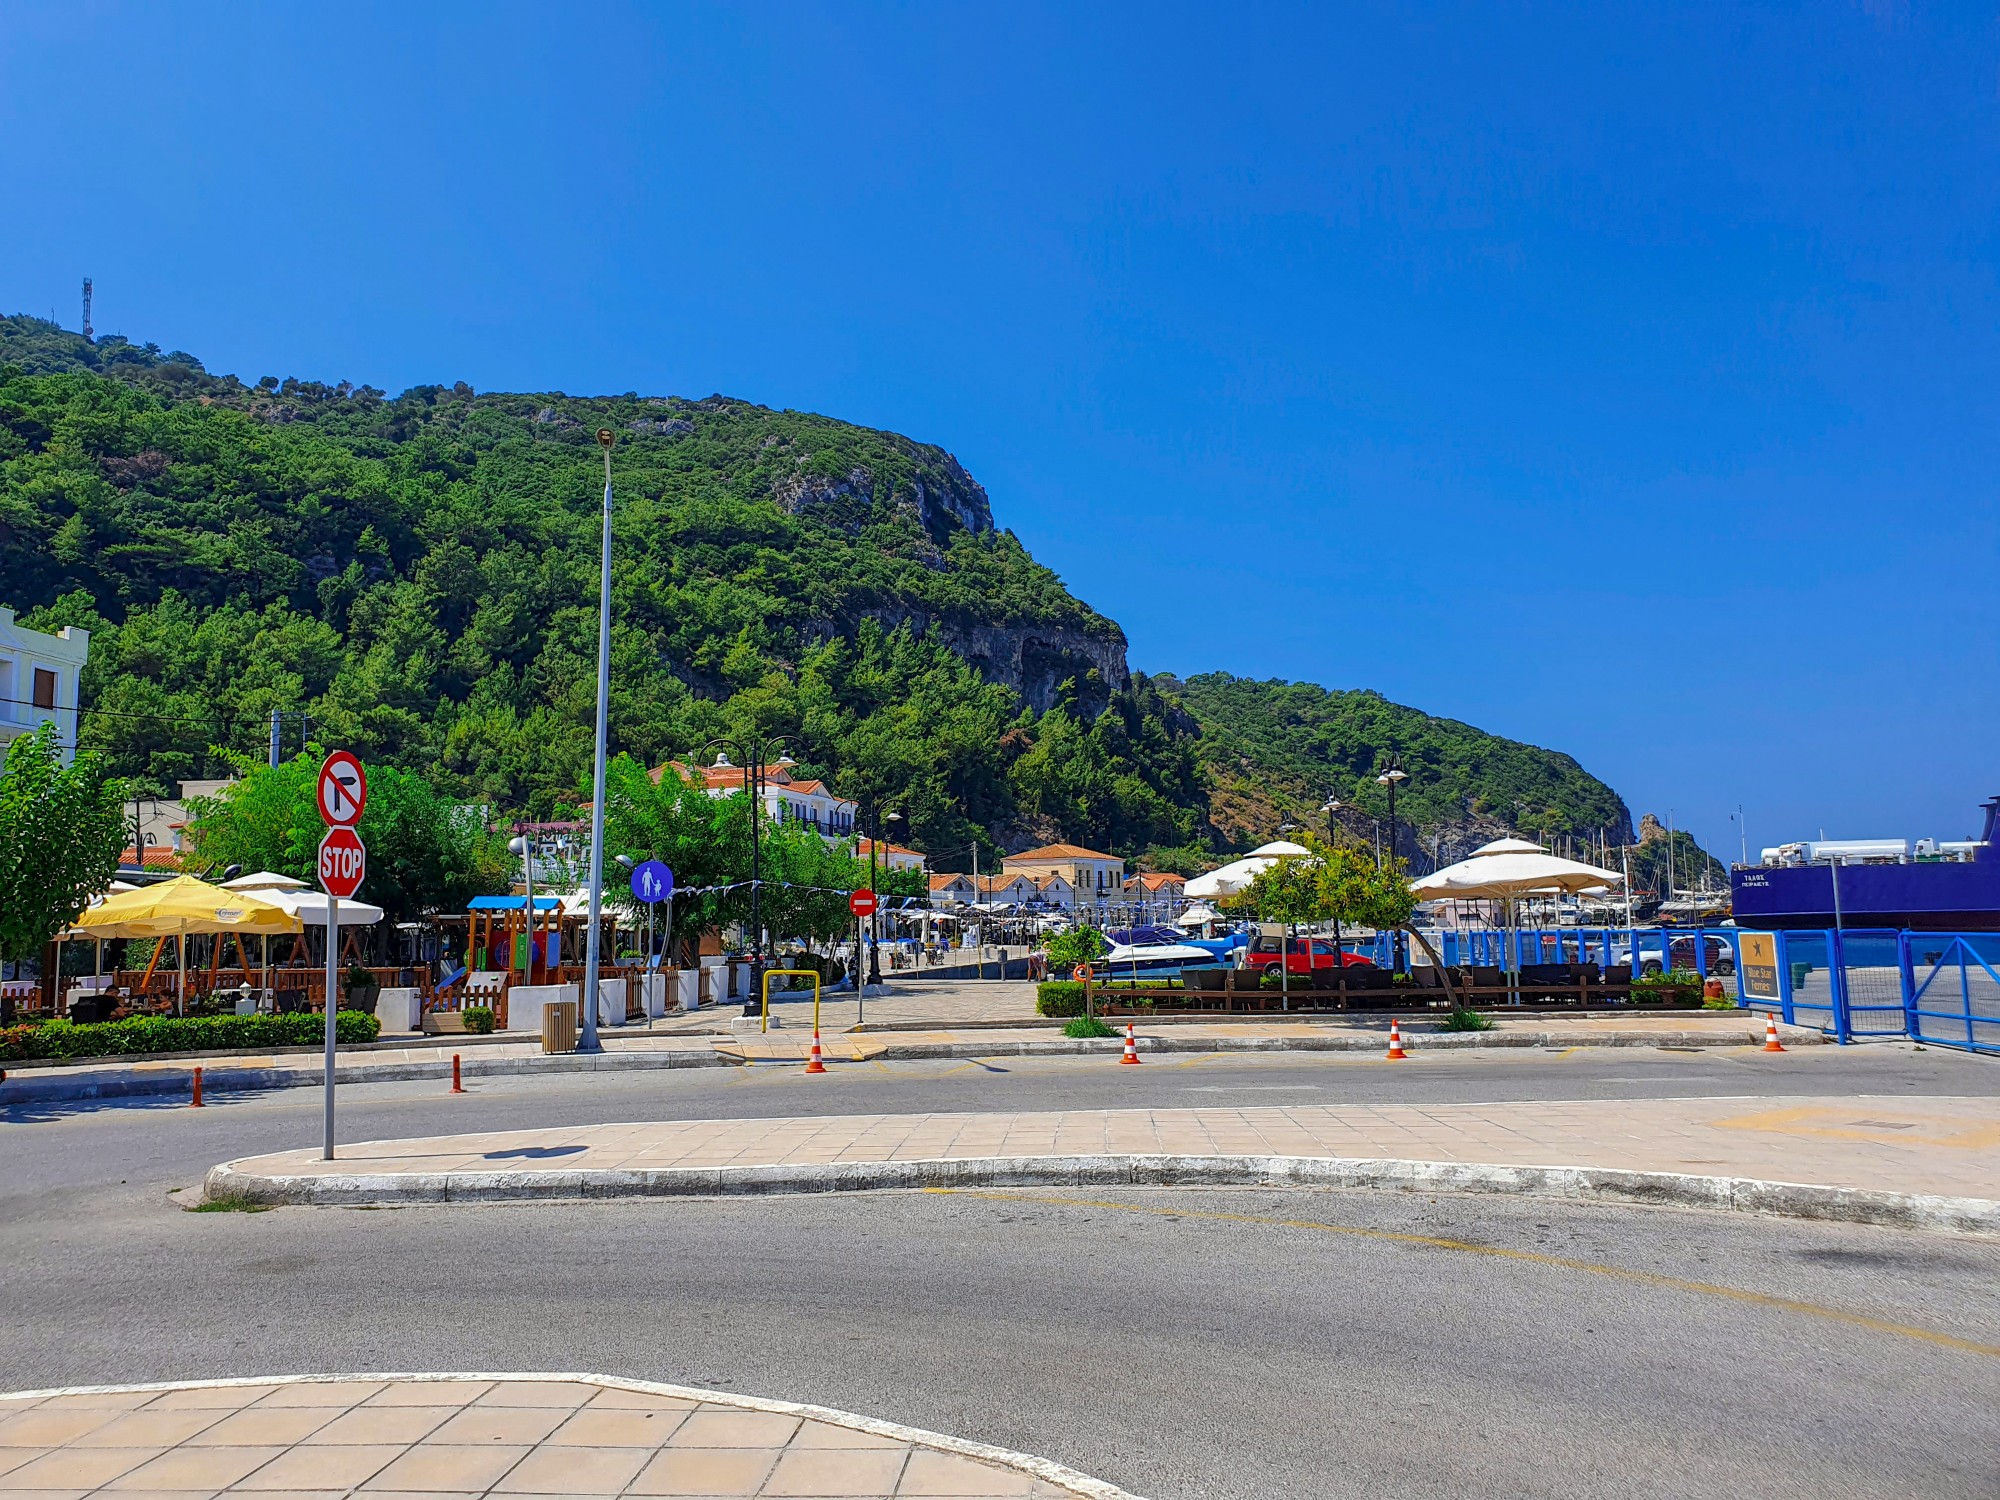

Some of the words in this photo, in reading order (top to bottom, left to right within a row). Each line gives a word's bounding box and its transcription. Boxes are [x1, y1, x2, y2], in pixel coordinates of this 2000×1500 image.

[322, 846, 362, 878] STOP
[1747, 966, 1760, 978] Blue
[1760, 967, 1772, 979] Star
[1751, 979, 1771, 992] Ferries
